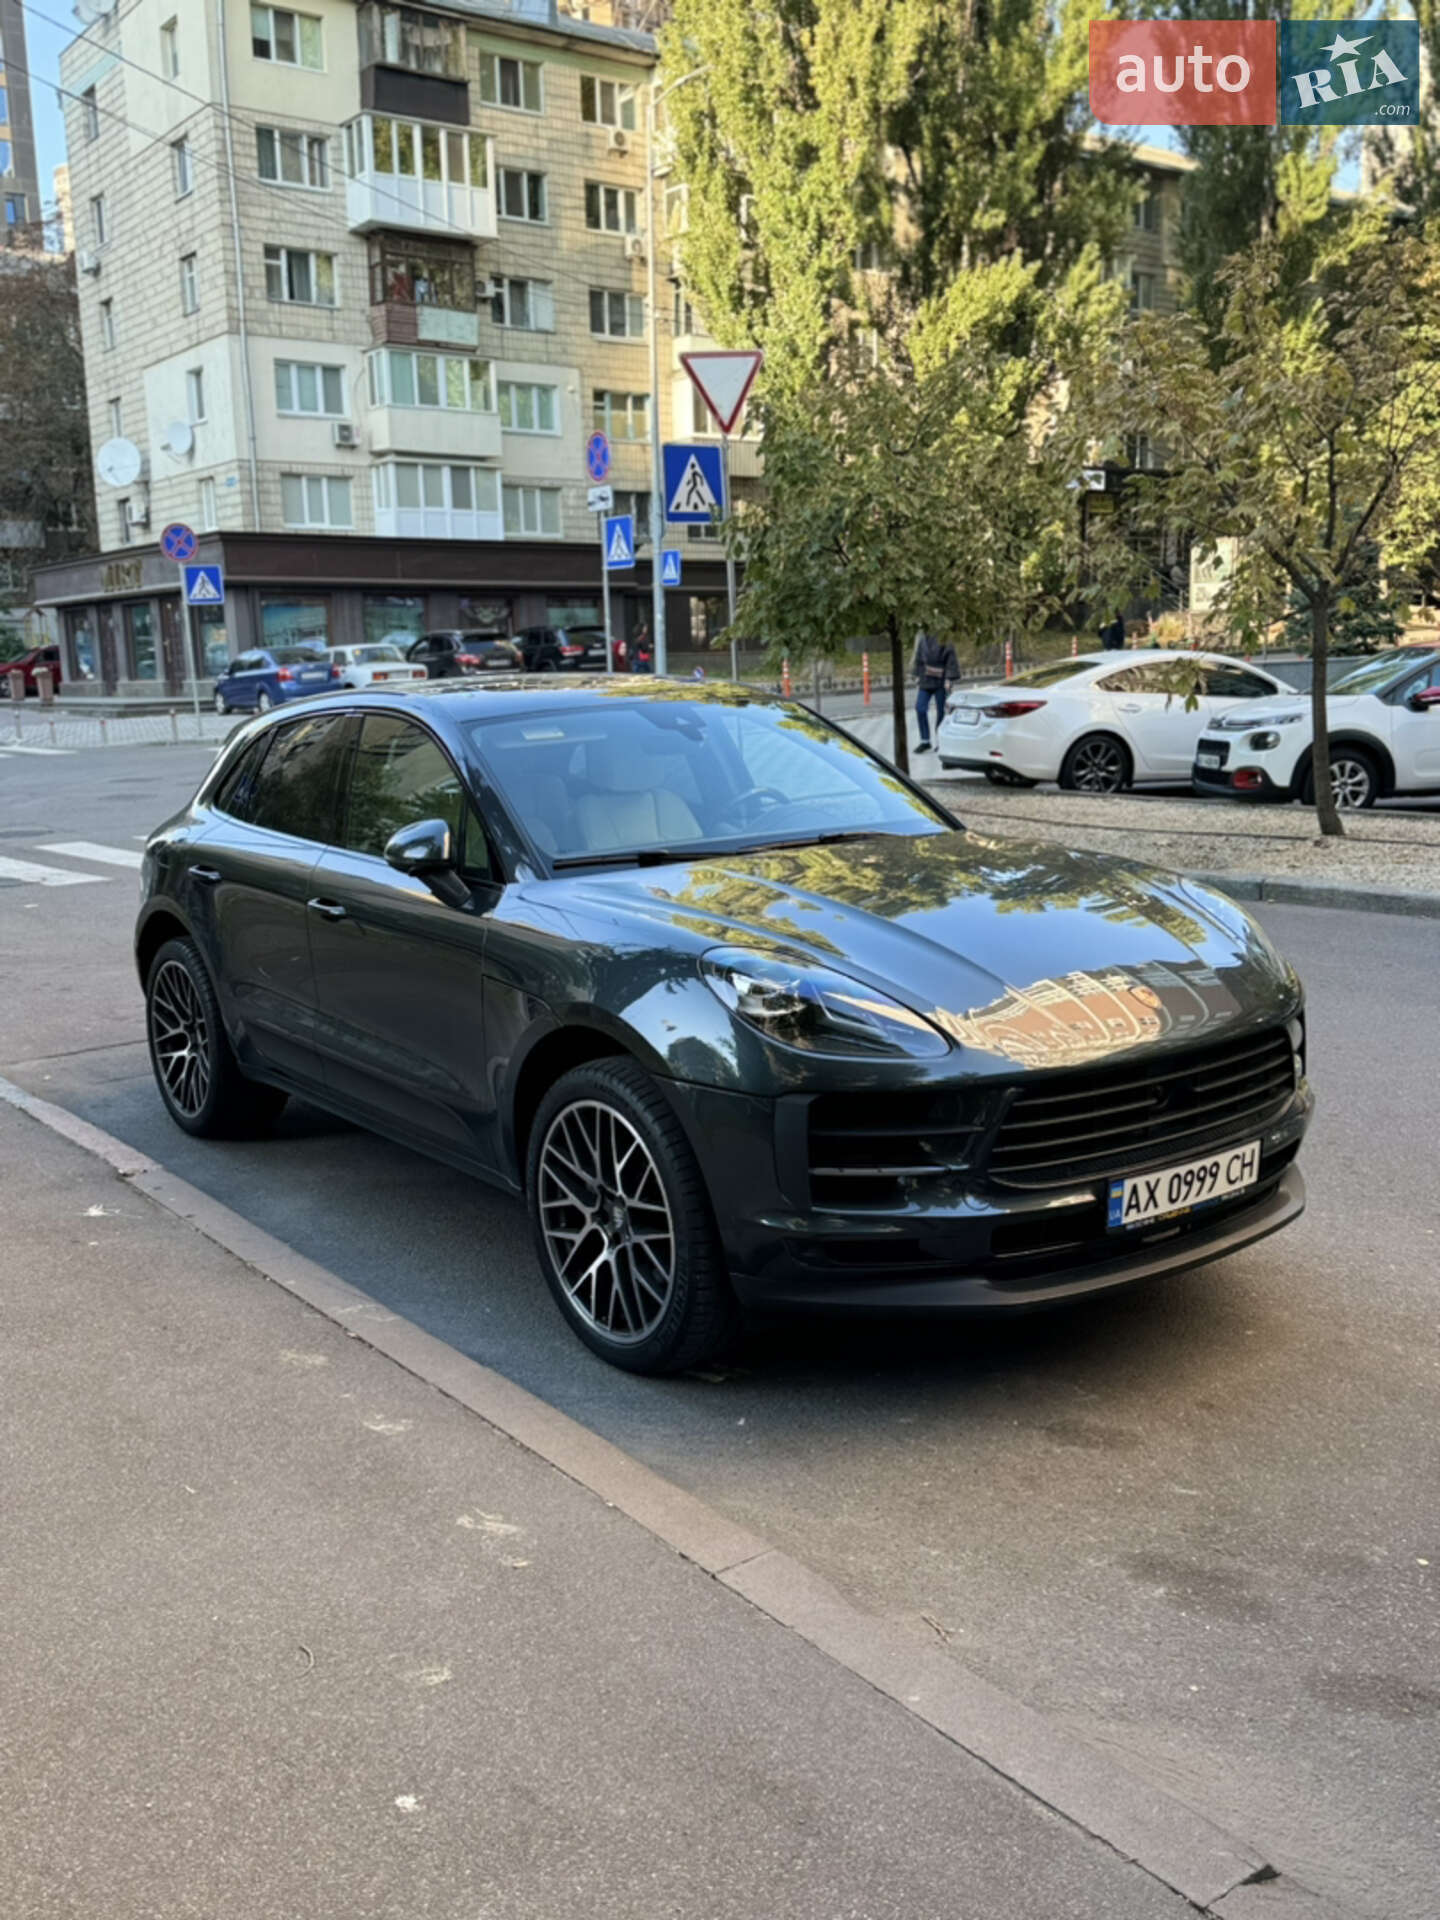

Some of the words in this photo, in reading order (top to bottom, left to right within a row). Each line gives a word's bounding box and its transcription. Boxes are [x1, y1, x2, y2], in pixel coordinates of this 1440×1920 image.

[1124, 1176, 1161, 1217] AX
[1167, 1161, 1221, 1205] 0999
[1226, 1148, 1256, 1186] CH
